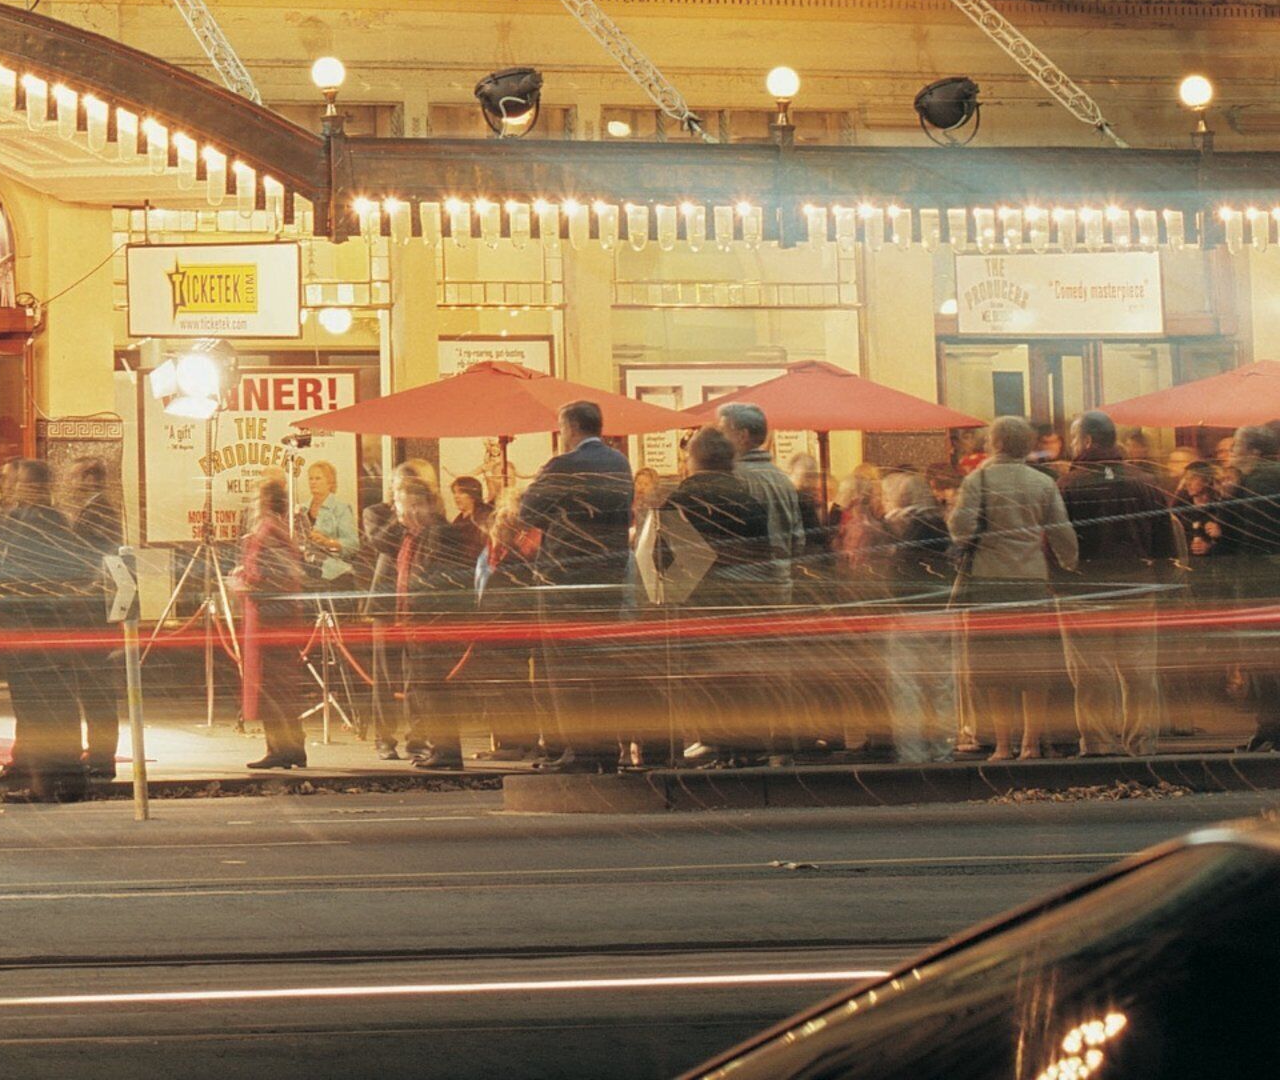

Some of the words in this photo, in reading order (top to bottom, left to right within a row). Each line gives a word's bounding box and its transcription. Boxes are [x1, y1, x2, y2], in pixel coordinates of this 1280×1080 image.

[984, 257, 1006, 278] THE
[167, 271, 241, 306] TICKETEK
[964, 279, 1030, 310] PRODUCERS
[180, 317, 248, 330] www.ticketek.com
[225, 378, 338, 411] NER!
[234, 418, 267, 441] THE
[198, 442, 306, 478] PRODUCERS
[226, 479, 243, 494] MEL
[188, 510, 212, 524] MOR
[214, 510, 237, 524] TONY
